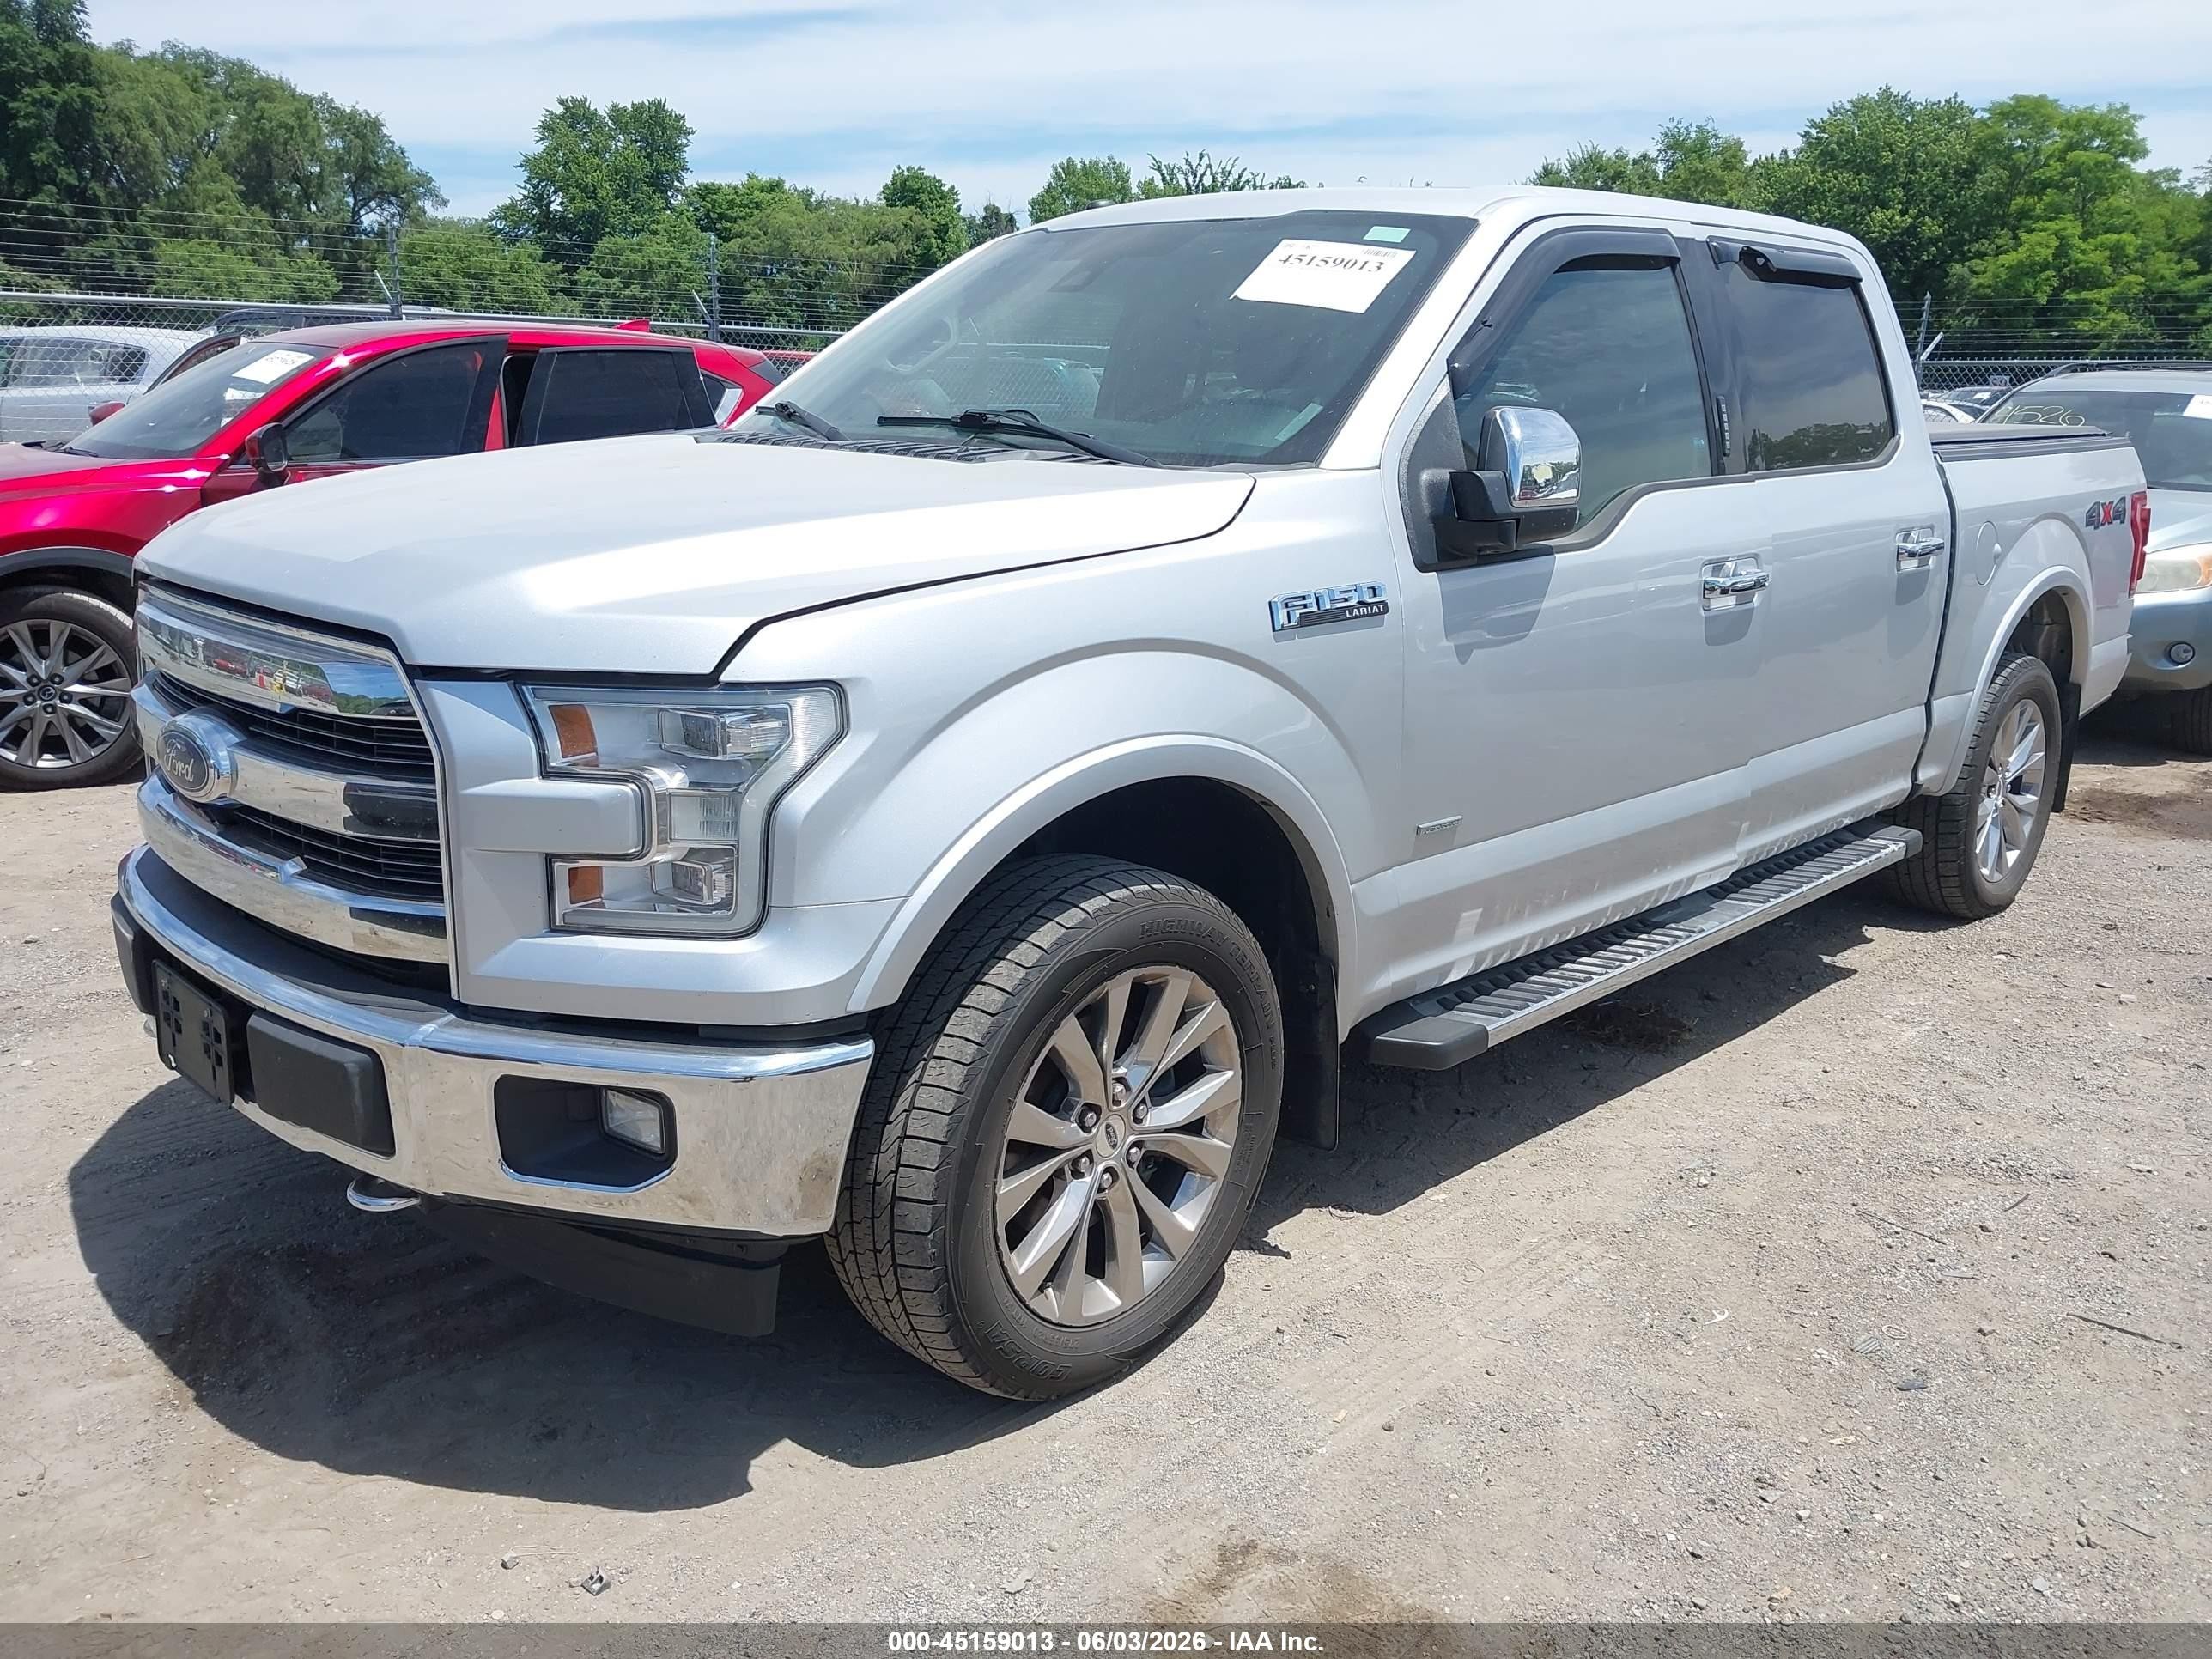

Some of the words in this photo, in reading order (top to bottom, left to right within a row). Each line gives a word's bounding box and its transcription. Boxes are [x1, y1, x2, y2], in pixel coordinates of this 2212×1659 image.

[1278, 253, 1386, 274] 45159013
[1346, 604, 1386, 618] LARIAT
[163, 738, 196, 782] Ford
[1139, 917, 1230, 947] HIGHWAY
[1229, 942, 1276, 1030] TERRAIN
[984, 1320, 1073, 1382] CORSA
